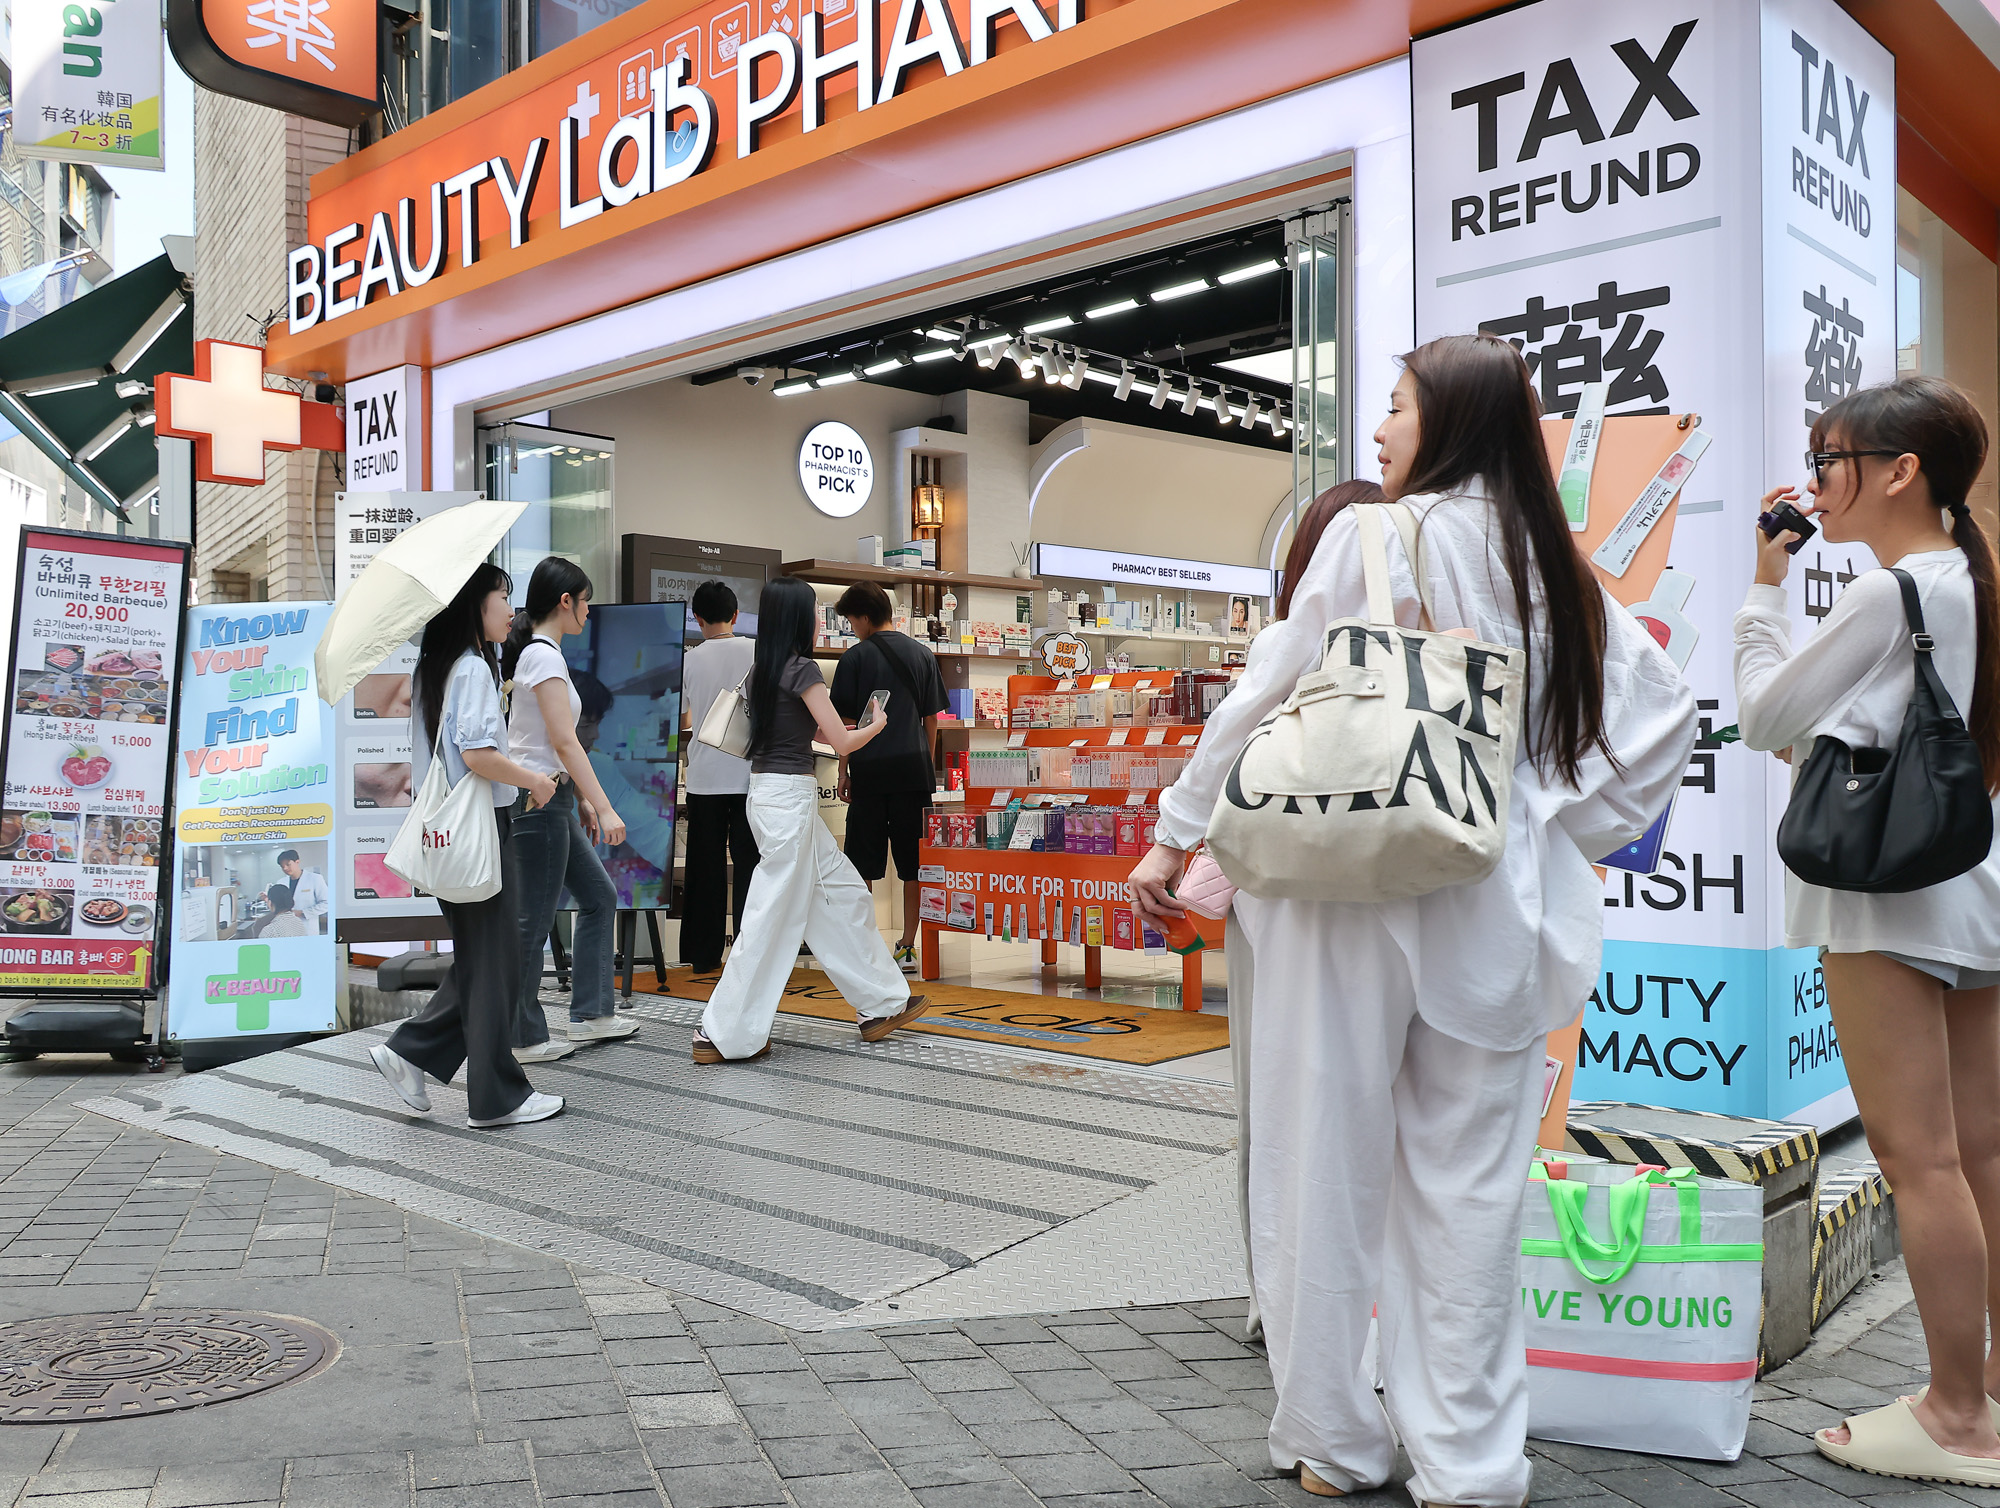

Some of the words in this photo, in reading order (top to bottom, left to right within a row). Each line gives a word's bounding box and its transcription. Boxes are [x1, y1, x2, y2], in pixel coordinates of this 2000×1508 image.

[63, 0, 104, 78] an
[97, 90, 132, 109] 韓国
[1451, 18, 1700, 173] TAX
[1791, 29, 1871, 180] TAX
[41, 106, 132, 130] 有名化妆品
[116, 134, 132, 150] 折
[289, 137, 548, 335] BEAUTY
[560, 58, 718, 230] Lab
[737, 0, 1078, 159] PHAR
[1451, 142, 1701, 242] REFUND
[1791, 145, 1871, 239] REFUND
[354, 390, 398, 446] TAX
[811, 443, 844, 462] TOP
[847, 449, 863, 465] 10
[354, 450, 398, 481] REFUND
[805, 460, 869, 478] PHARMACIST'S
[818, 476, 855, 494] PICK
[1639, 487, 1672, 528] 노스카나
[349, 528, 404, 543] 重回婴
[39, 553, 74, 573] 숙성
[1112, 562, 1157, 577] PHARMACY
[1158, 567, 1177, 579] BEST
[1179, 569, 1212, 582] SELLERS
[38, 571, 92, 590] 바베큐
[99, 575, 166, 597] 무한리필
[35, 585, 99, 602] (Unlimited
[104, 593, 168, 609] Barbeque)
[65, 602, 129, 622] 20,900
[200, 608, 309, 648] Know
[132, 637, 146, 646] bar
[149, 639, 166, 648] free
[1056, 642, 1078, 655] BEST
[191, 645, 269, 676] Your
[1052, 655, 1076, 669] PICK
[227, 664, 308, 702] Skin
[1322, 626, 1509, 742] TLE
[204, 697, 299, 747] Find
[111, 735, 152, 747] 15,000
[184, 743, 268, 778] Your
[29, 786, 74, 797] 샤브샤브
[104, 788, 145, 802] 점심뷔페
[198, 763, 328, 805] Solution
[817, 785, 838, 800] Rej
[220, 807, 248, 816] Don't
[247, 807, 268, 816] just
[269, 806, 289, 815] buy
[183, 821, 202, 830] Get
[202, 820, 249, 829] Products
[250, 816, 325, 827] Recommended
[221, 832, 237, 841] for
[239, 832, 263, 840] Your
[264, 830, 287, 839] Skin
[12, 865, 47, 877] 갈비탕
[945, 870, 983, 891] BEST
[989, 873, 1026, 894] PICK
[1032, 876, 1064, 897] FOR
[40, 950, 75, 965] BAR
[77, 949, 105, 965] 홍빠
[108, 952, 124, 964] 3F
[207, 977, 301, 997] K-BEAUTY
[1597, 1293, 1733, 1328] YOUNG
